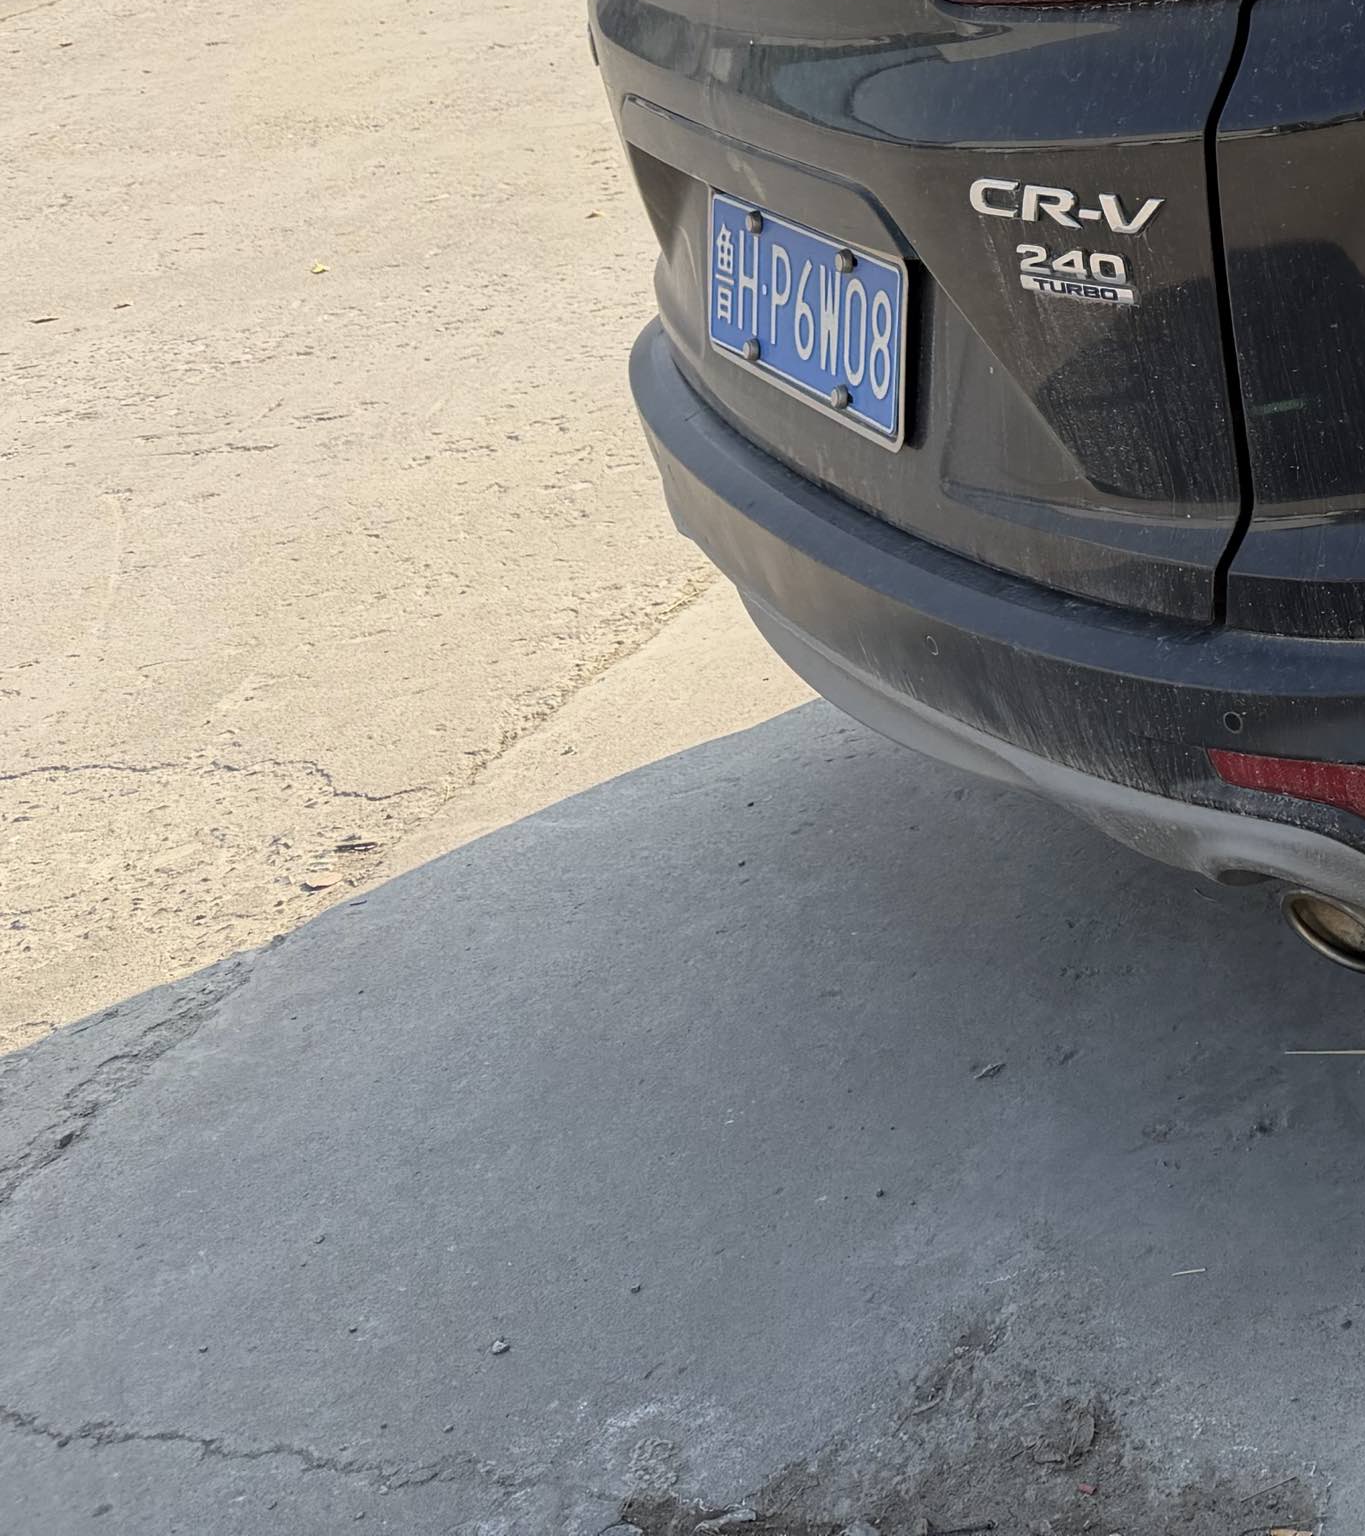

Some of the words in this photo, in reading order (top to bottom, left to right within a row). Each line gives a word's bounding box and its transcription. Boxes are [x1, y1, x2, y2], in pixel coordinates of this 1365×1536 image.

[969, 176, 1167, 236] CR-V
[1015, 242, 1129, 285] 240
[1031, 277, 1119, 302] TURBO
